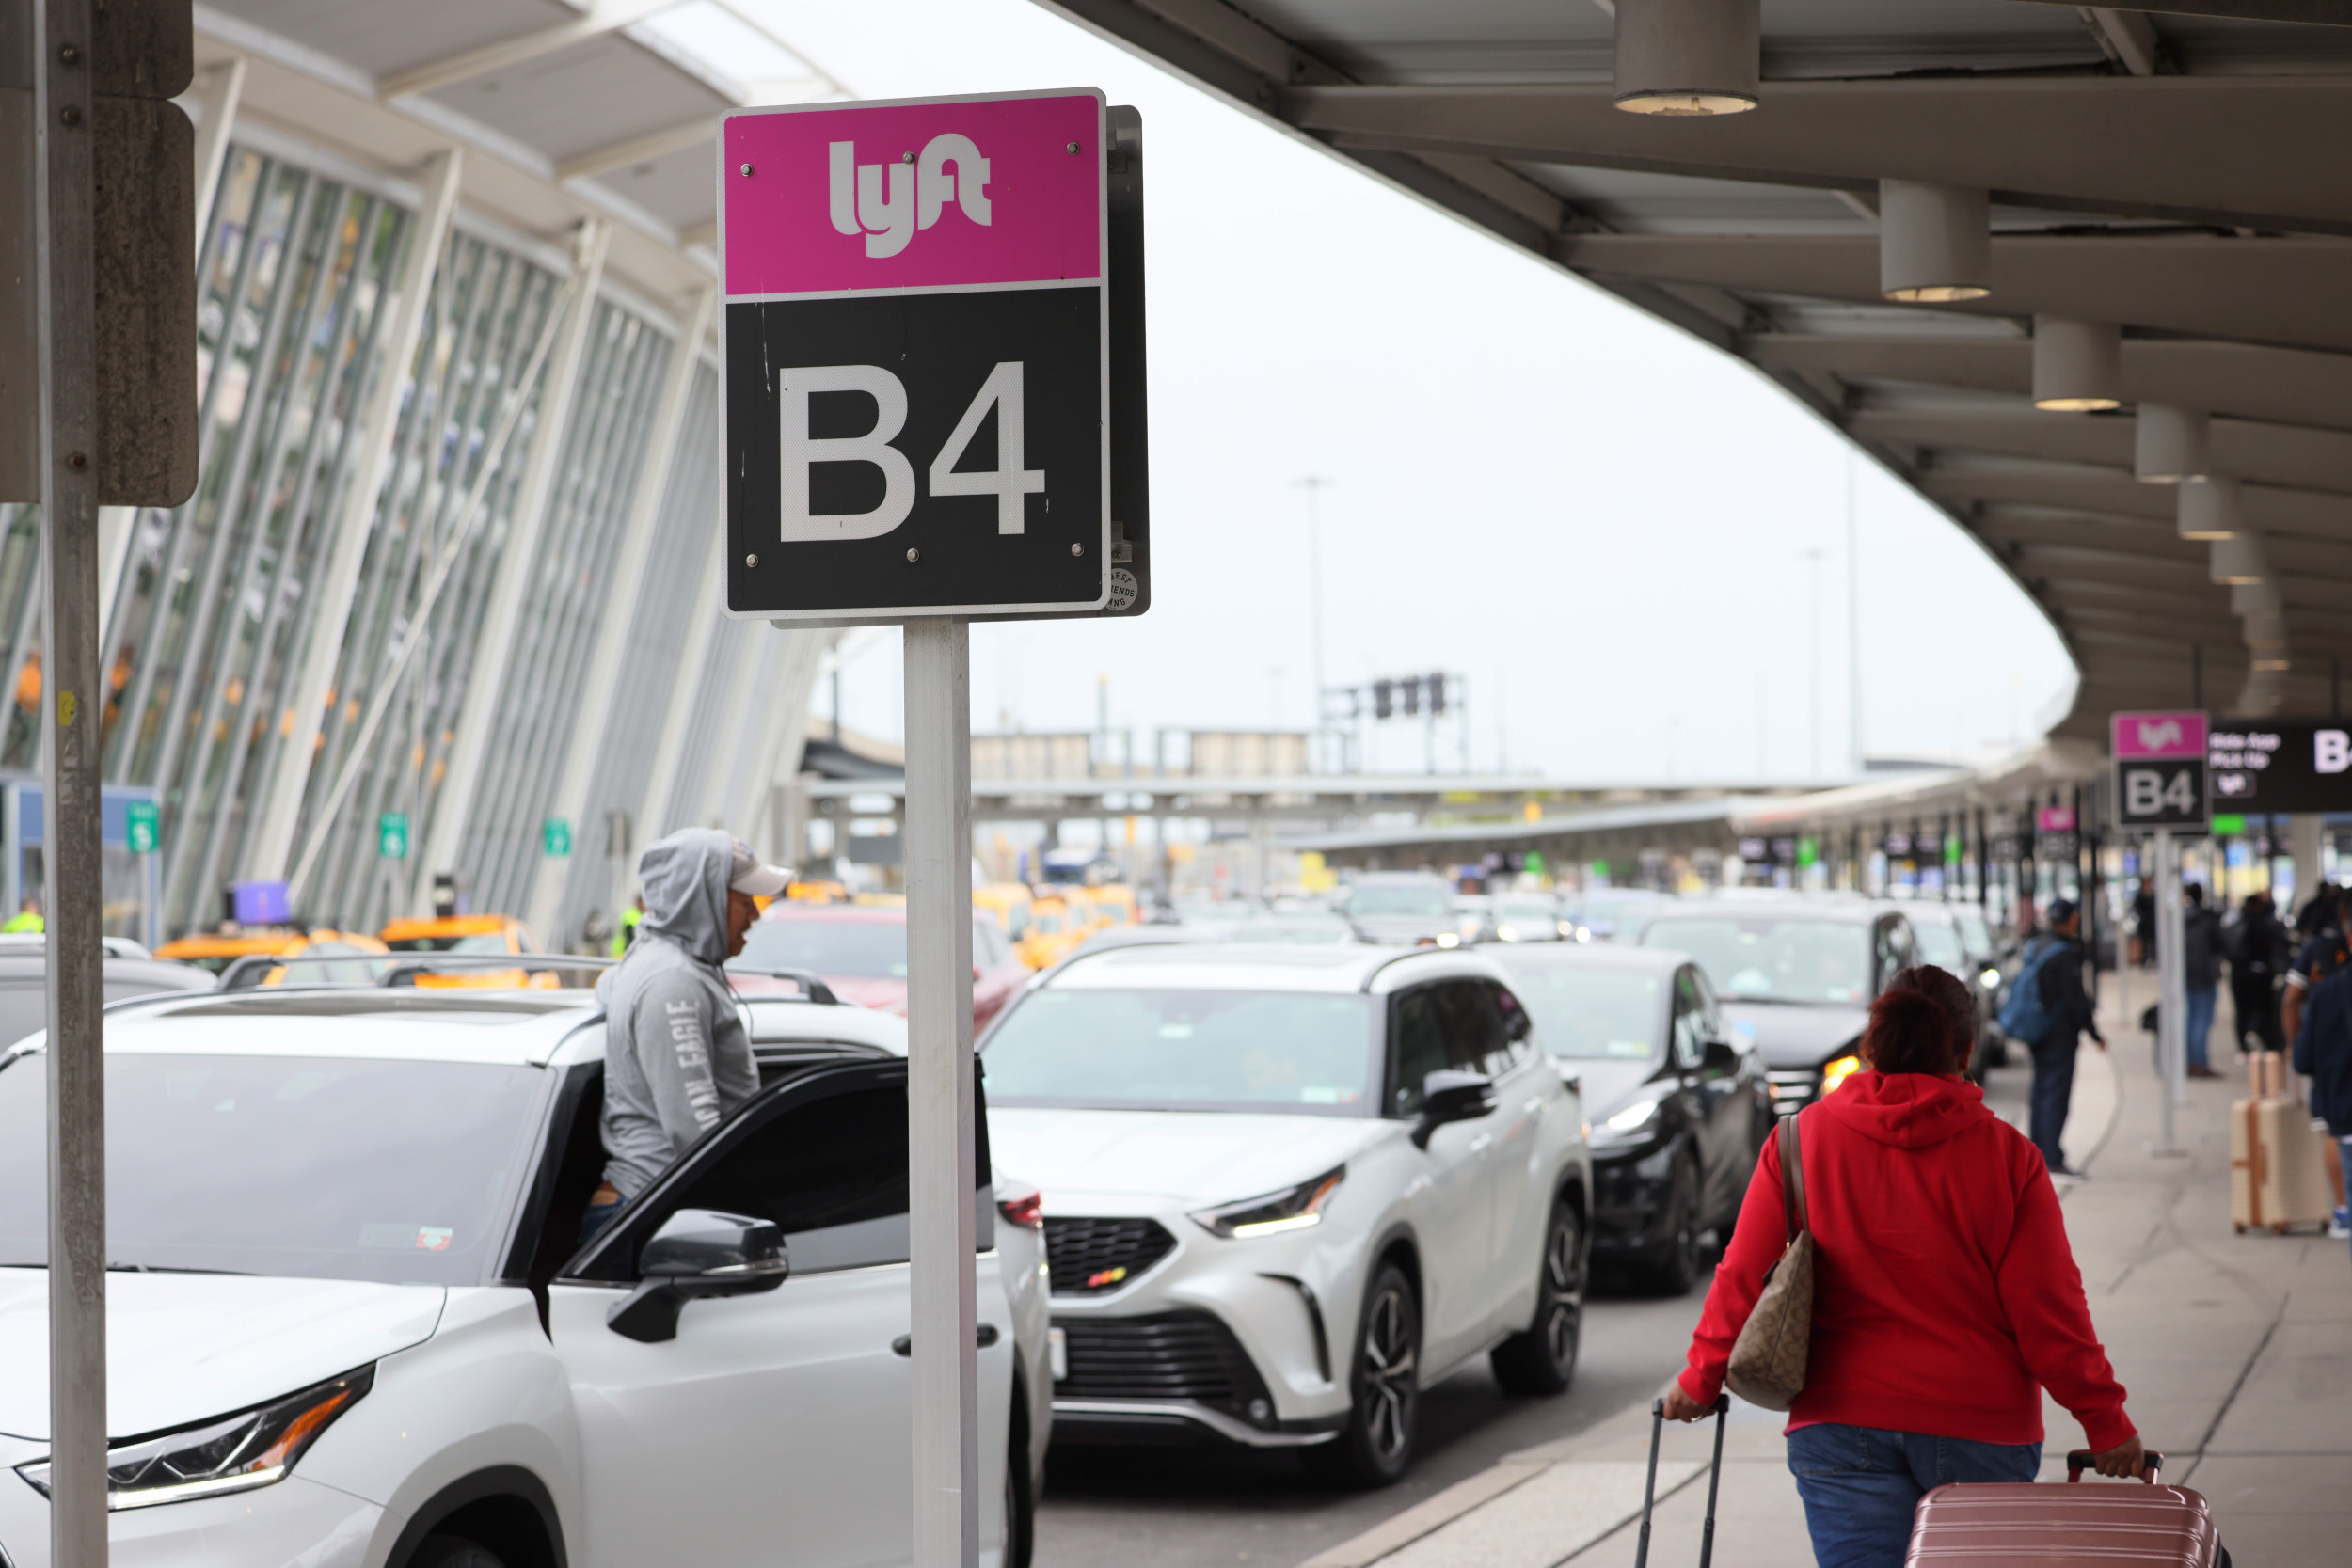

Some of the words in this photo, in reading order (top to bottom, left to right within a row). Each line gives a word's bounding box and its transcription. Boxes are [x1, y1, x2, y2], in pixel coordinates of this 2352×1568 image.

[829, 133, 992, 259] lyft
[779, 361, 1045, 542] B4
[1108, 598, 1126, 607] ANG
[1111, 584, 1136, 597] IENDS
[2314, 730, 2352, 773] B
[2126, 769, 2197, 816] B4
[684, 1079, 721, 1132] ICAN
